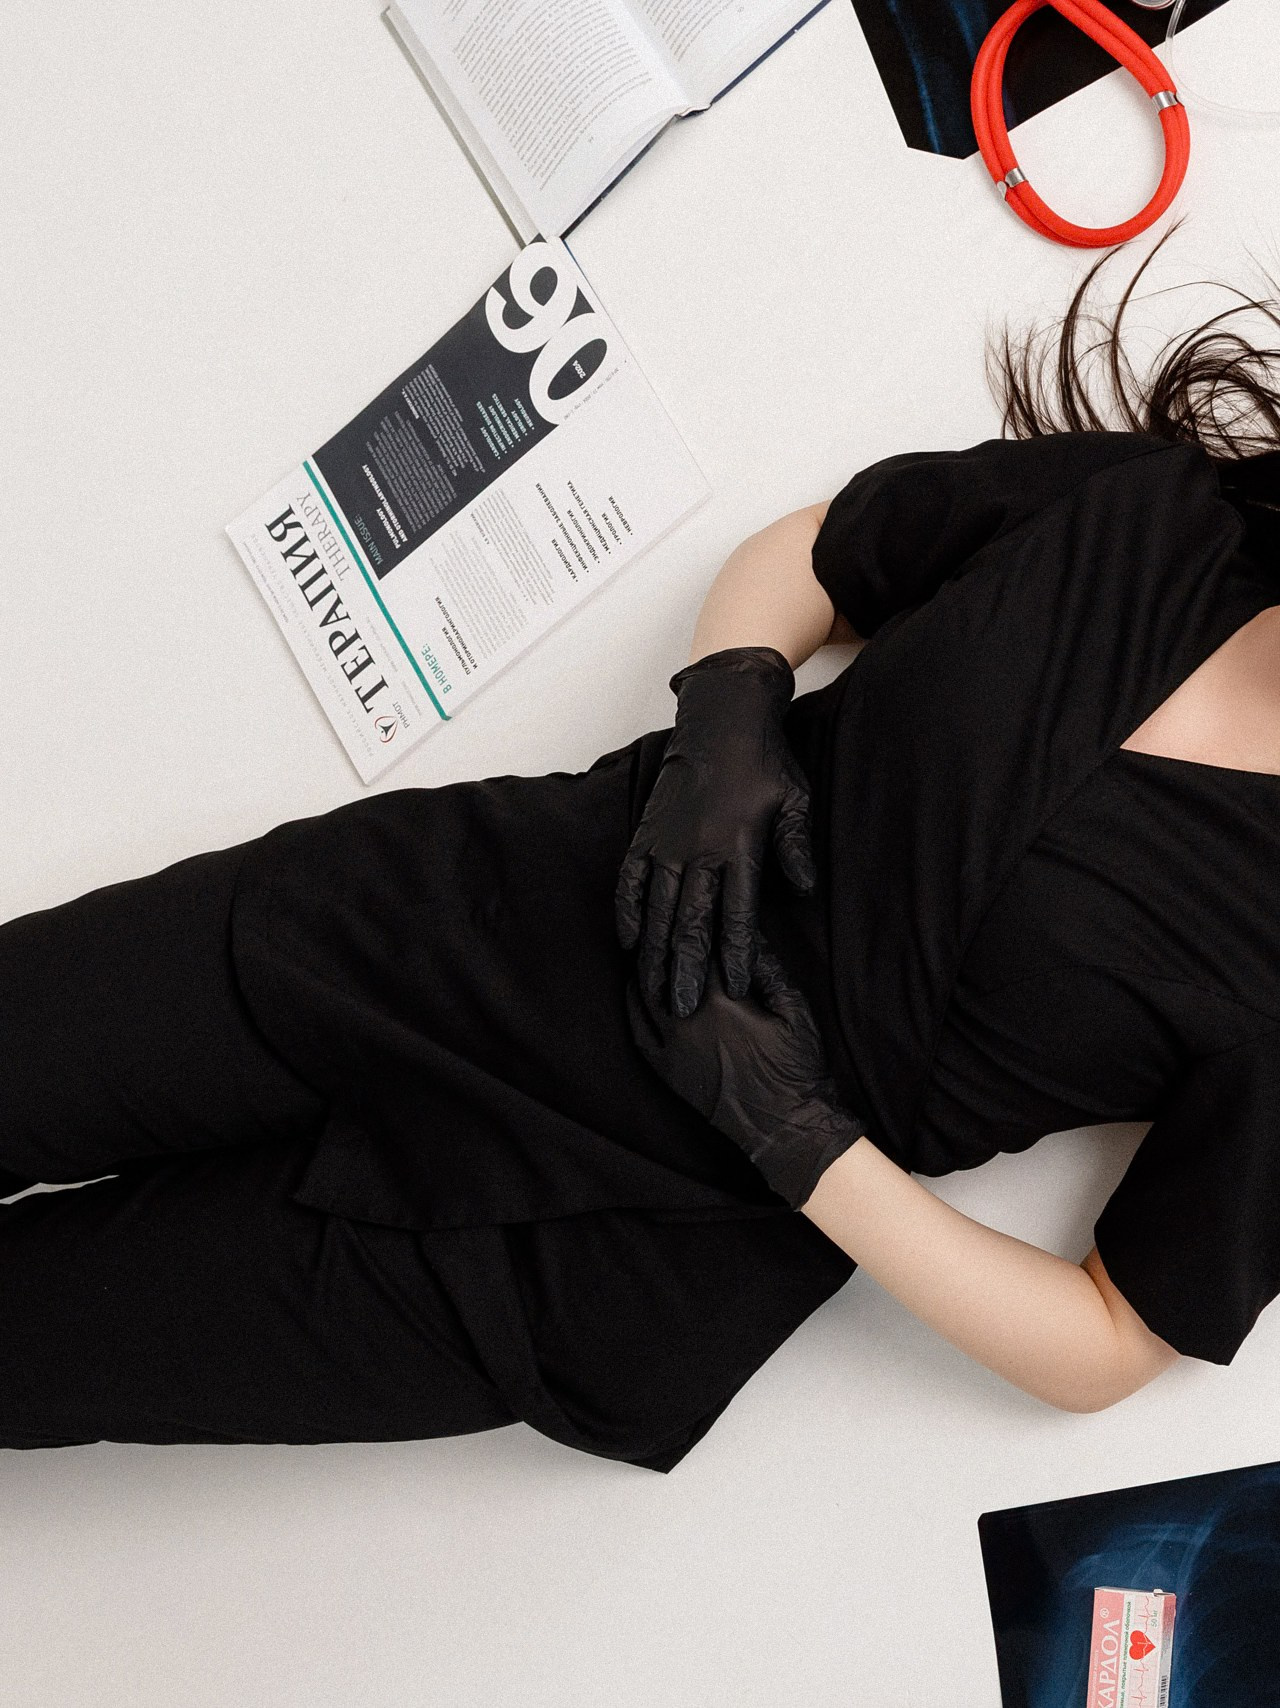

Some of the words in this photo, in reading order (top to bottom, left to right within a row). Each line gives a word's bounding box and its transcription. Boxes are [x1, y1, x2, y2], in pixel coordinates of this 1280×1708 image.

[571, 359, 586, 379] 2024
[475, 400, 492, 425] DISEASES
[490, 392, 508, 418] GENETICS
[513, 396, 534, 427] NEUROLOGY
[486, 404, 513, 445] ENDOCRINOLOGY
[504, 415, 520, 439] MEDICAL
[510, 409, 527, 433] UROLOGY
[479, 425, 500, 457] CARDIOLOGY
[488, 423, 507, 451] INFECTION
[360, 462, 402, 531] OTORHINOLARYNGOLOGY
[534, 482, 561, 523] ЗАБОЛЕВАНИЯ
[565, 479, 586, 510] ГЕНЕТИКА
[352, 512, 372, 543] ISSUE:
[374, 505, 402, 549] PULMONOLOGY
[581, 507, 610, 551] МЕДИЦИНСКАЯ
[600, 511, 621, 542] УРОЛОГИЯ
[607, 495, 632, 533] НЕВРОЛОГИЯ
[294, 487, 353, 582] THERAPY
[397, 528, 408, 543] AND
[557, 521, 588, 570] ИНФЕКЦИОННЫЕ
[565, 508, 600, 561] ЭНДОКРИНОЛОГИЯ
[367, 540, 384, 565] MAIN
[550, 537, 577, 579] КАРДИОЛОГИЯ
[263, 501, 393, 714] ТЕРАПИЯ
[434, 595, 475, 664] ОТОРИНОЛАРИНГОЛОГИЯ
[419, 641, 448, 686] НОМЕРЕ:
[441, 625, 471, 675] ПУЛЬМОНОЛОГИЯ
[441, 682, 452, 694] В
[392, 700, 410, 728] РНМОТ
[1123, 1601, 1133, 1630] оболочкой
[1150, 1618, 1157, 1627] 50
